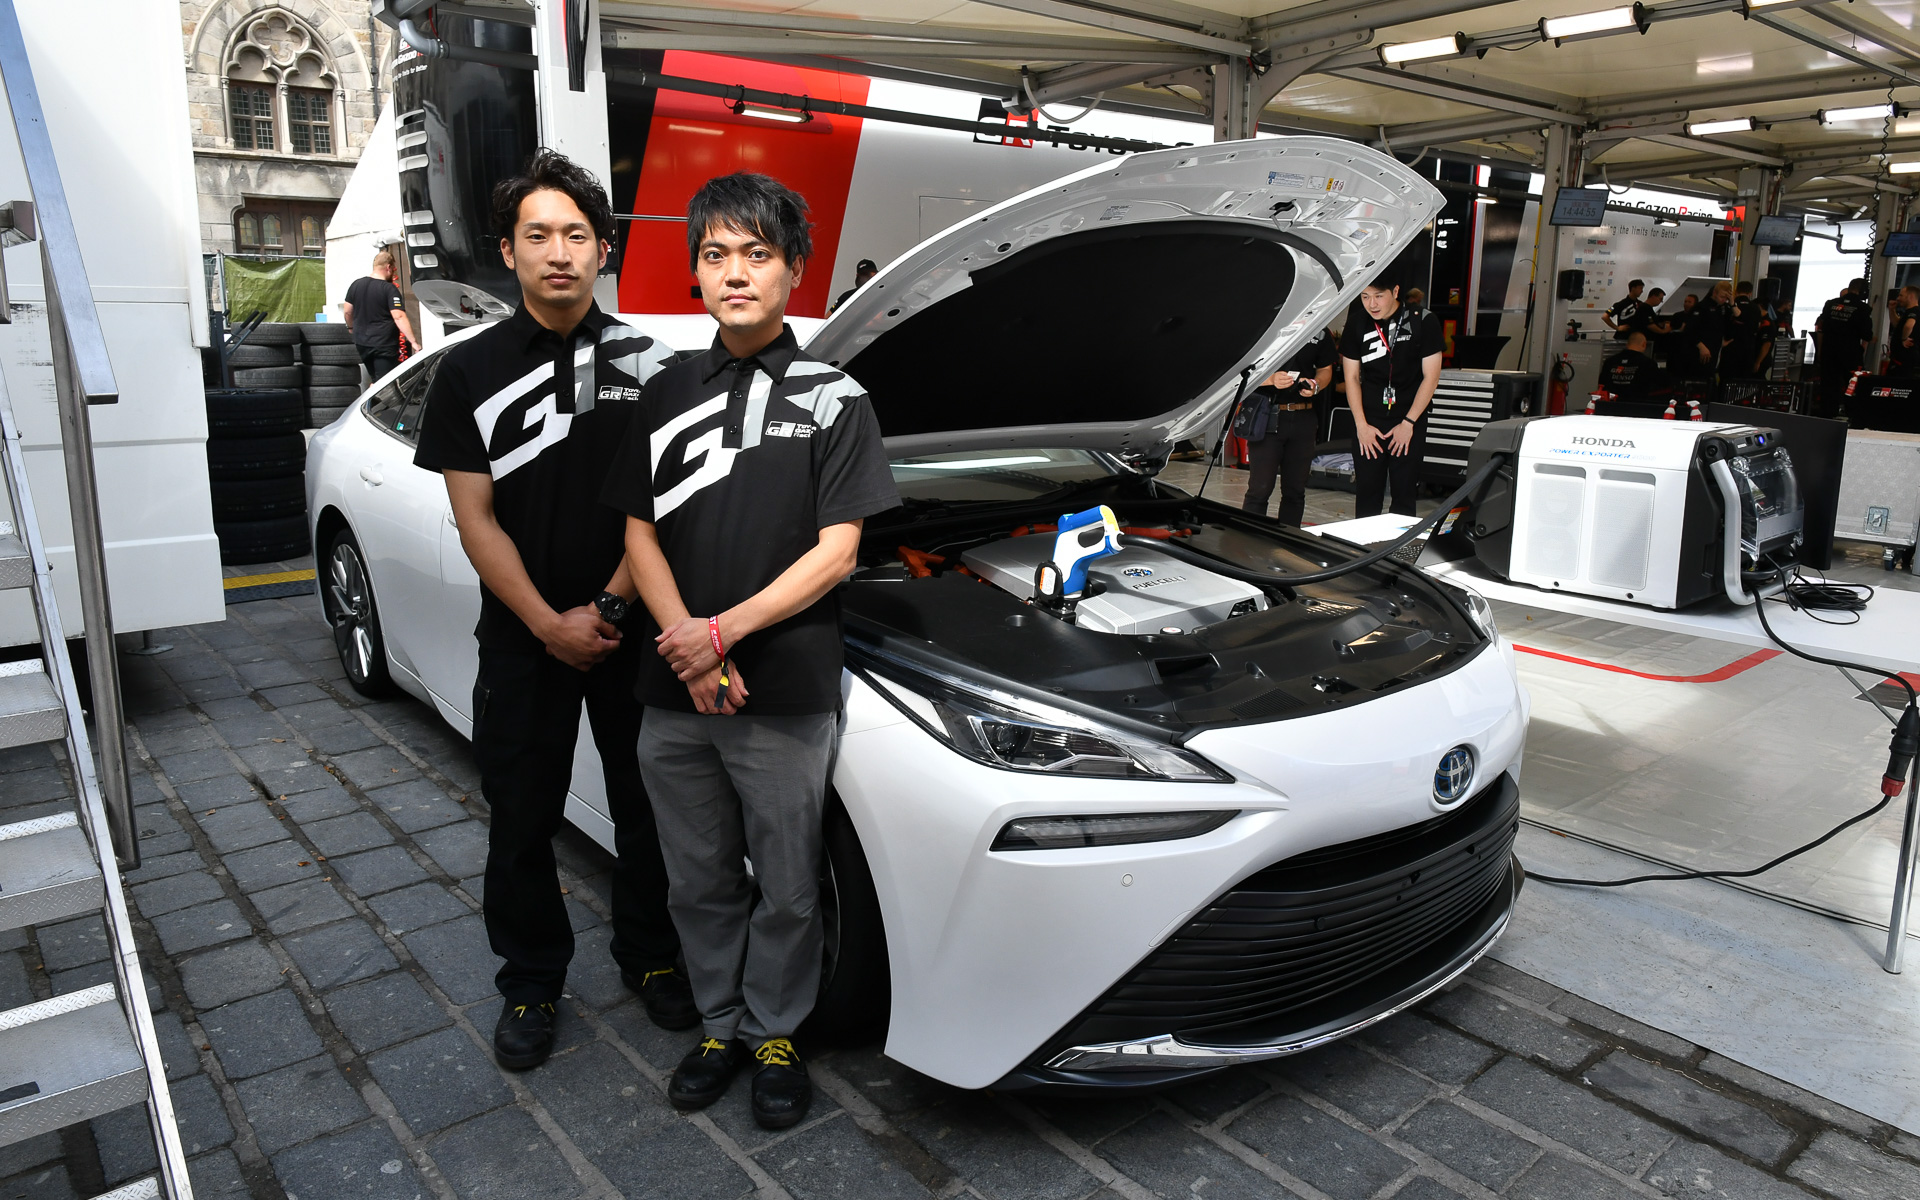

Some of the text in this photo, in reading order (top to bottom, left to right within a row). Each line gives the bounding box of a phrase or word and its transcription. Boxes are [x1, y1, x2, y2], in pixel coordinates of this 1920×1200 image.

[1562, 207, 1596, 218] 14:44:55
[1661, 229, 1679, 239] Better
[1571, 436, 1636, 449] HONDA
[1581, 451, 1631, 459] EXPORTER
